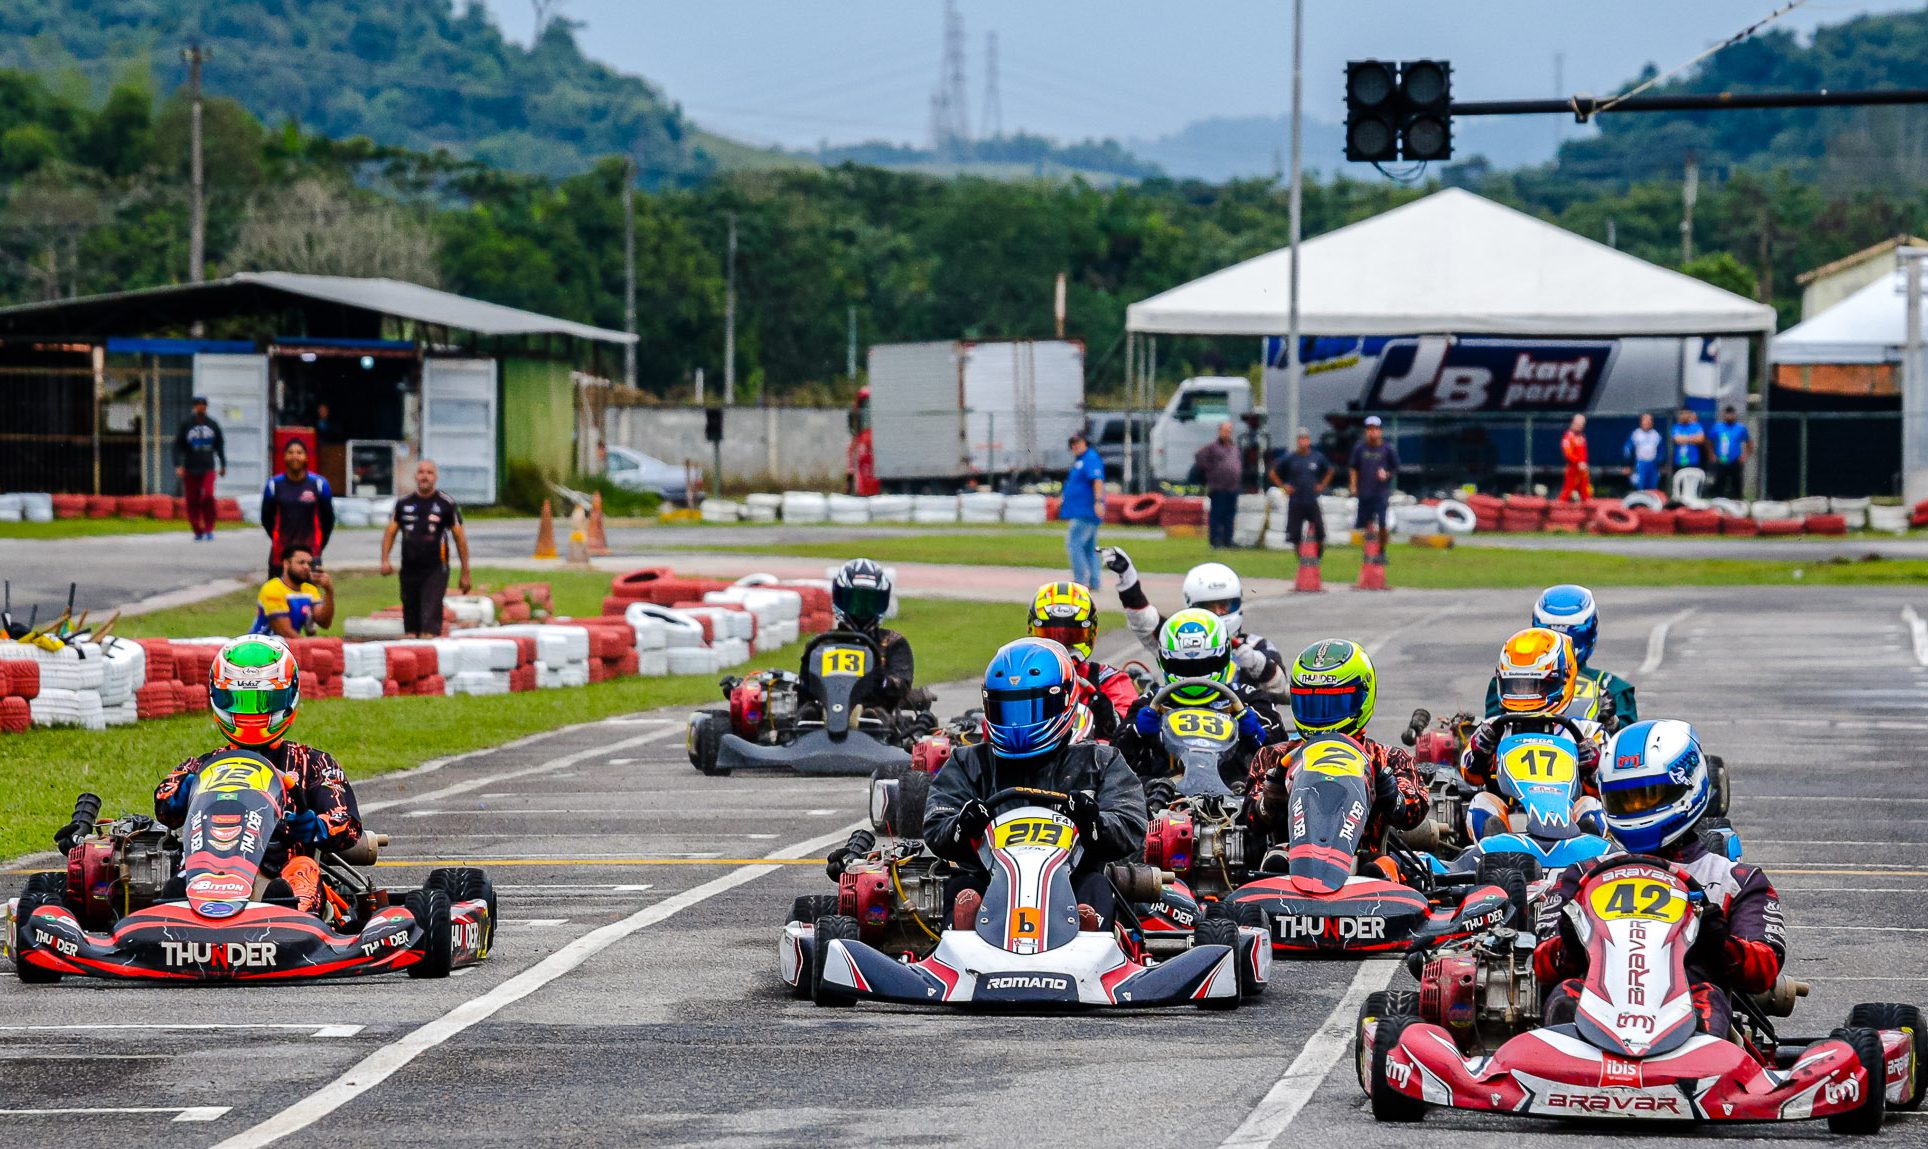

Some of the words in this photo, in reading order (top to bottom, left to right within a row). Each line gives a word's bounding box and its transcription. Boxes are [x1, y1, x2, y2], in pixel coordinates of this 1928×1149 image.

[1379, 335, 1492, 409] JB
[1513, 353, 1590, 380] kart
[1502, 379, 1582, 407] parts
[828, 653, 860, 672] 13
[1301, 674, 1337, 683] THUNDER
[1178, 713, 1223, 735] 33
[1312, 747, 1357, 767] 2
[1521, 749, 1557, 776] 17
[240, 811, 263, 854] THUNDER
[1056, 816, 1069, 825] F4
[1339, 801, 1365, 841] THUNDER
[1005, 823, 1062, 845] 213
[191, 880, 244, 892] BITTON
[1605, 884, 1671, 918] 42
[1018, 912, 1036, 933] b
[1276, 916, 1386, 941] THUNDER
[1462, 909, 1503, 932] THUNDER
[35, 929, 79, 957] THUNDER
[361, 930, 410, 957] THUNDER
[452, 922, 481, 951] HUNDER
[161, 942, 277, 970] THUNDER
[986, 977, 1068, 990] ROMANO
[1606, 1060, 1637, 1076] ibis
